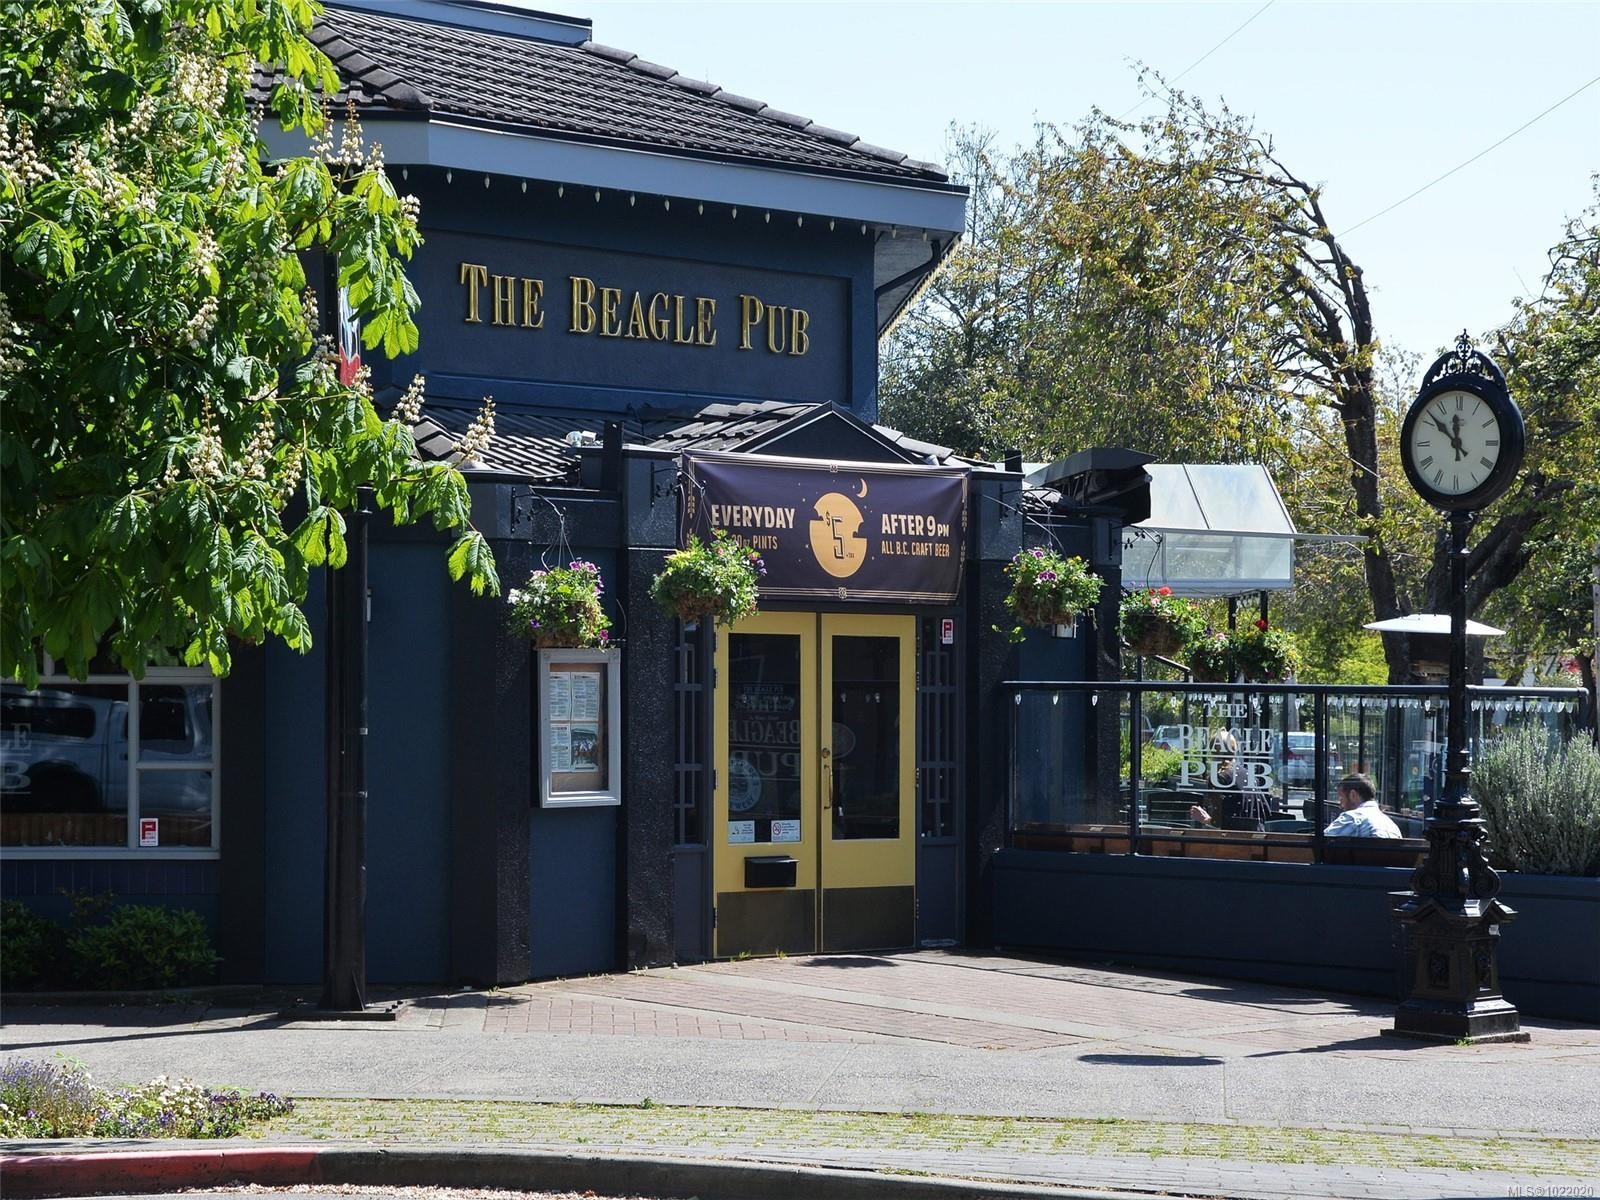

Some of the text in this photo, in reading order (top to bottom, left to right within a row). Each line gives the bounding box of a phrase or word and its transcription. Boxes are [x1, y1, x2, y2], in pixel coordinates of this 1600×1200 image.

[460, 262, 811, 356] THE BEAGLE PUB
[711, 504, 795, 529] EVERYDAY
[881, 513, 925, 536] AFTER
[752, 534, 778, 550] PINTS
[881, 540, 950, 558] ALL B.C. CRAFT BEER
[1203, 702, 1248, 718] THE
[1176, 723, 1275, 754] BEAGLE
[1176, 760, 1274, 790] PUB
